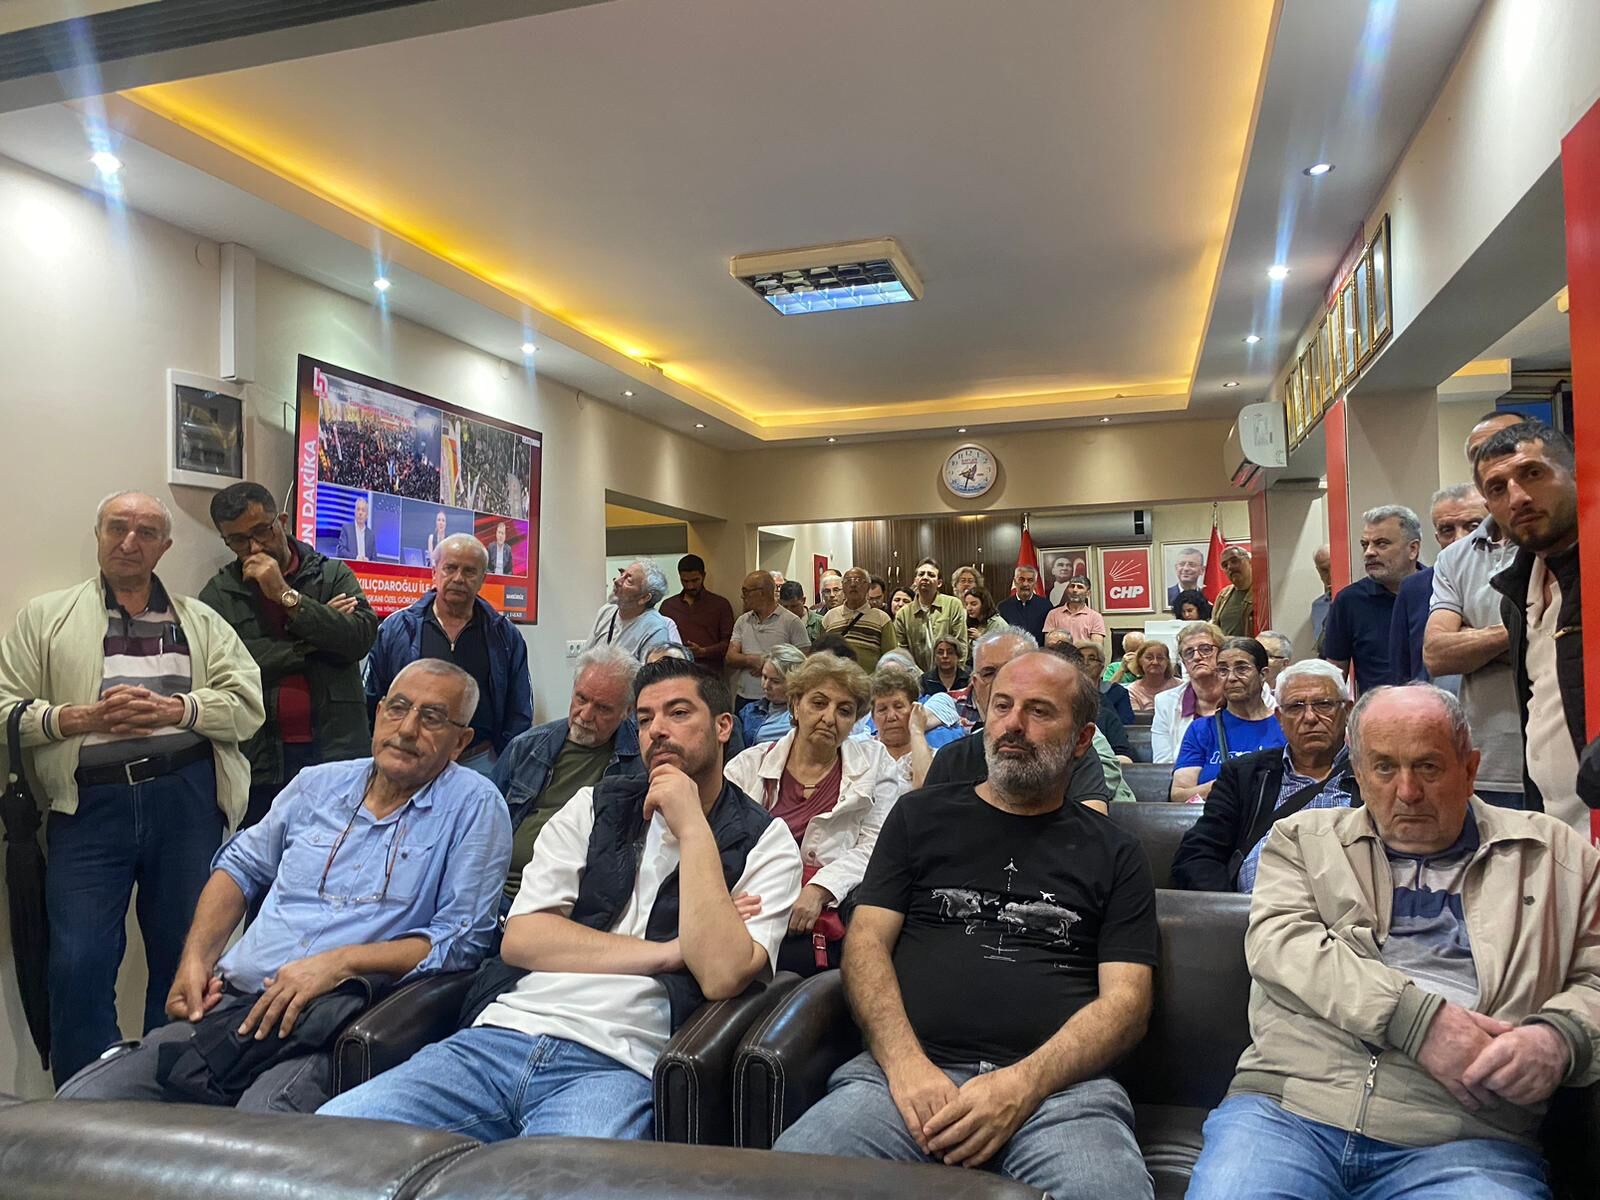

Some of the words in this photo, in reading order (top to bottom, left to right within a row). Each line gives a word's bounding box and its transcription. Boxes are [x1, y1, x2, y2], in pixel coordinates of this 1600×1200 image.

[301, 439, 317, 518] DAKİKA
[301, 525, 315, 547] ON
[1109, 586, 1144, 599] CHP
